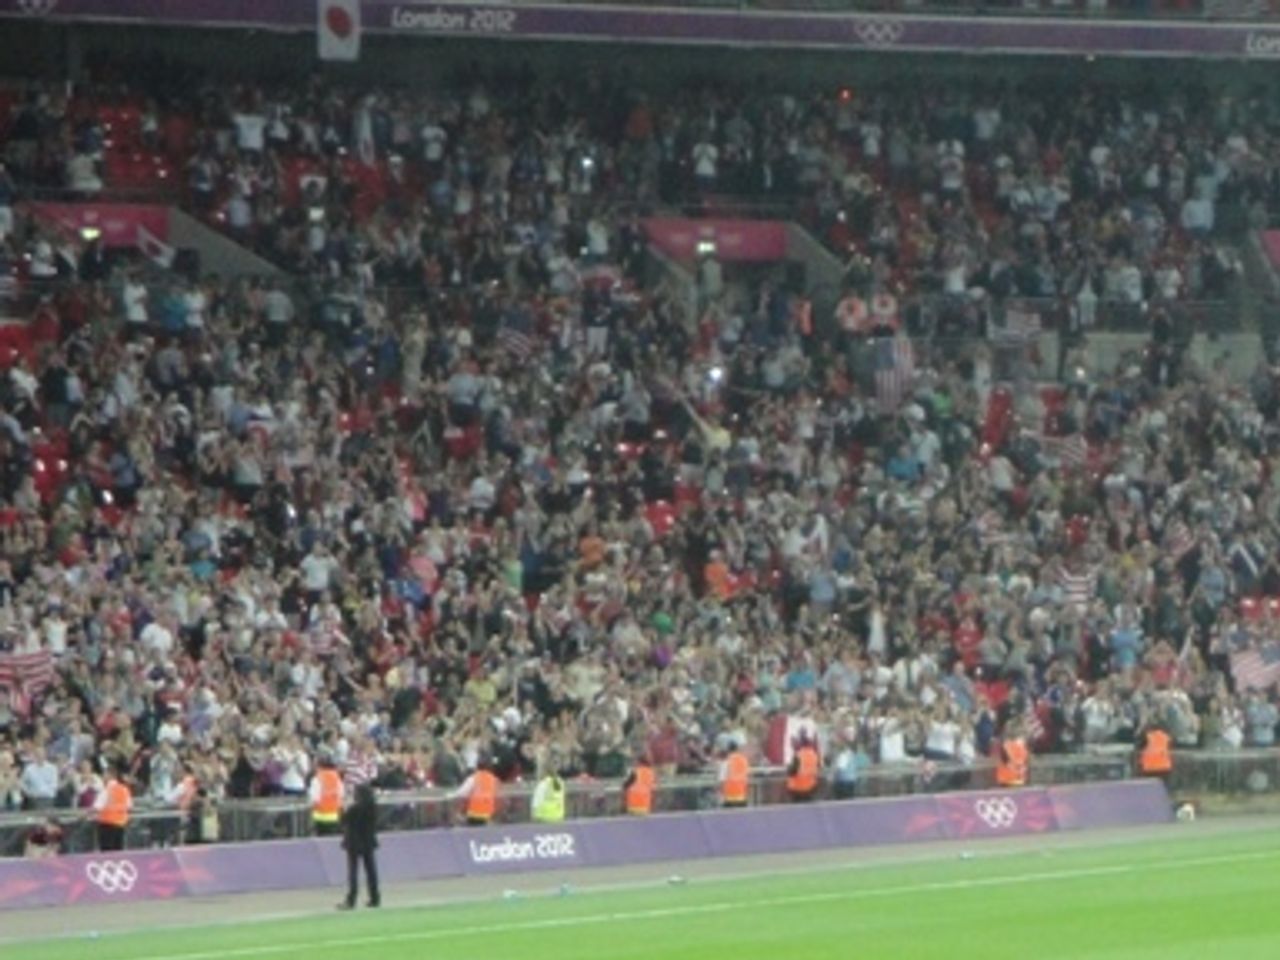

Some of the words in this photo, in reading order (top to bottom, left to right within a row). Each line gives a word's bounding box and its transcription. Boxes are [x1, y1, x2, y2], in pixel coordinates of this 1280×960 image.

[391, 5, 465, 29] London
[469, 8, 517, 32] 2012
[468, 835, 534, 863] London
[532, 832, 576, 859] 2012
